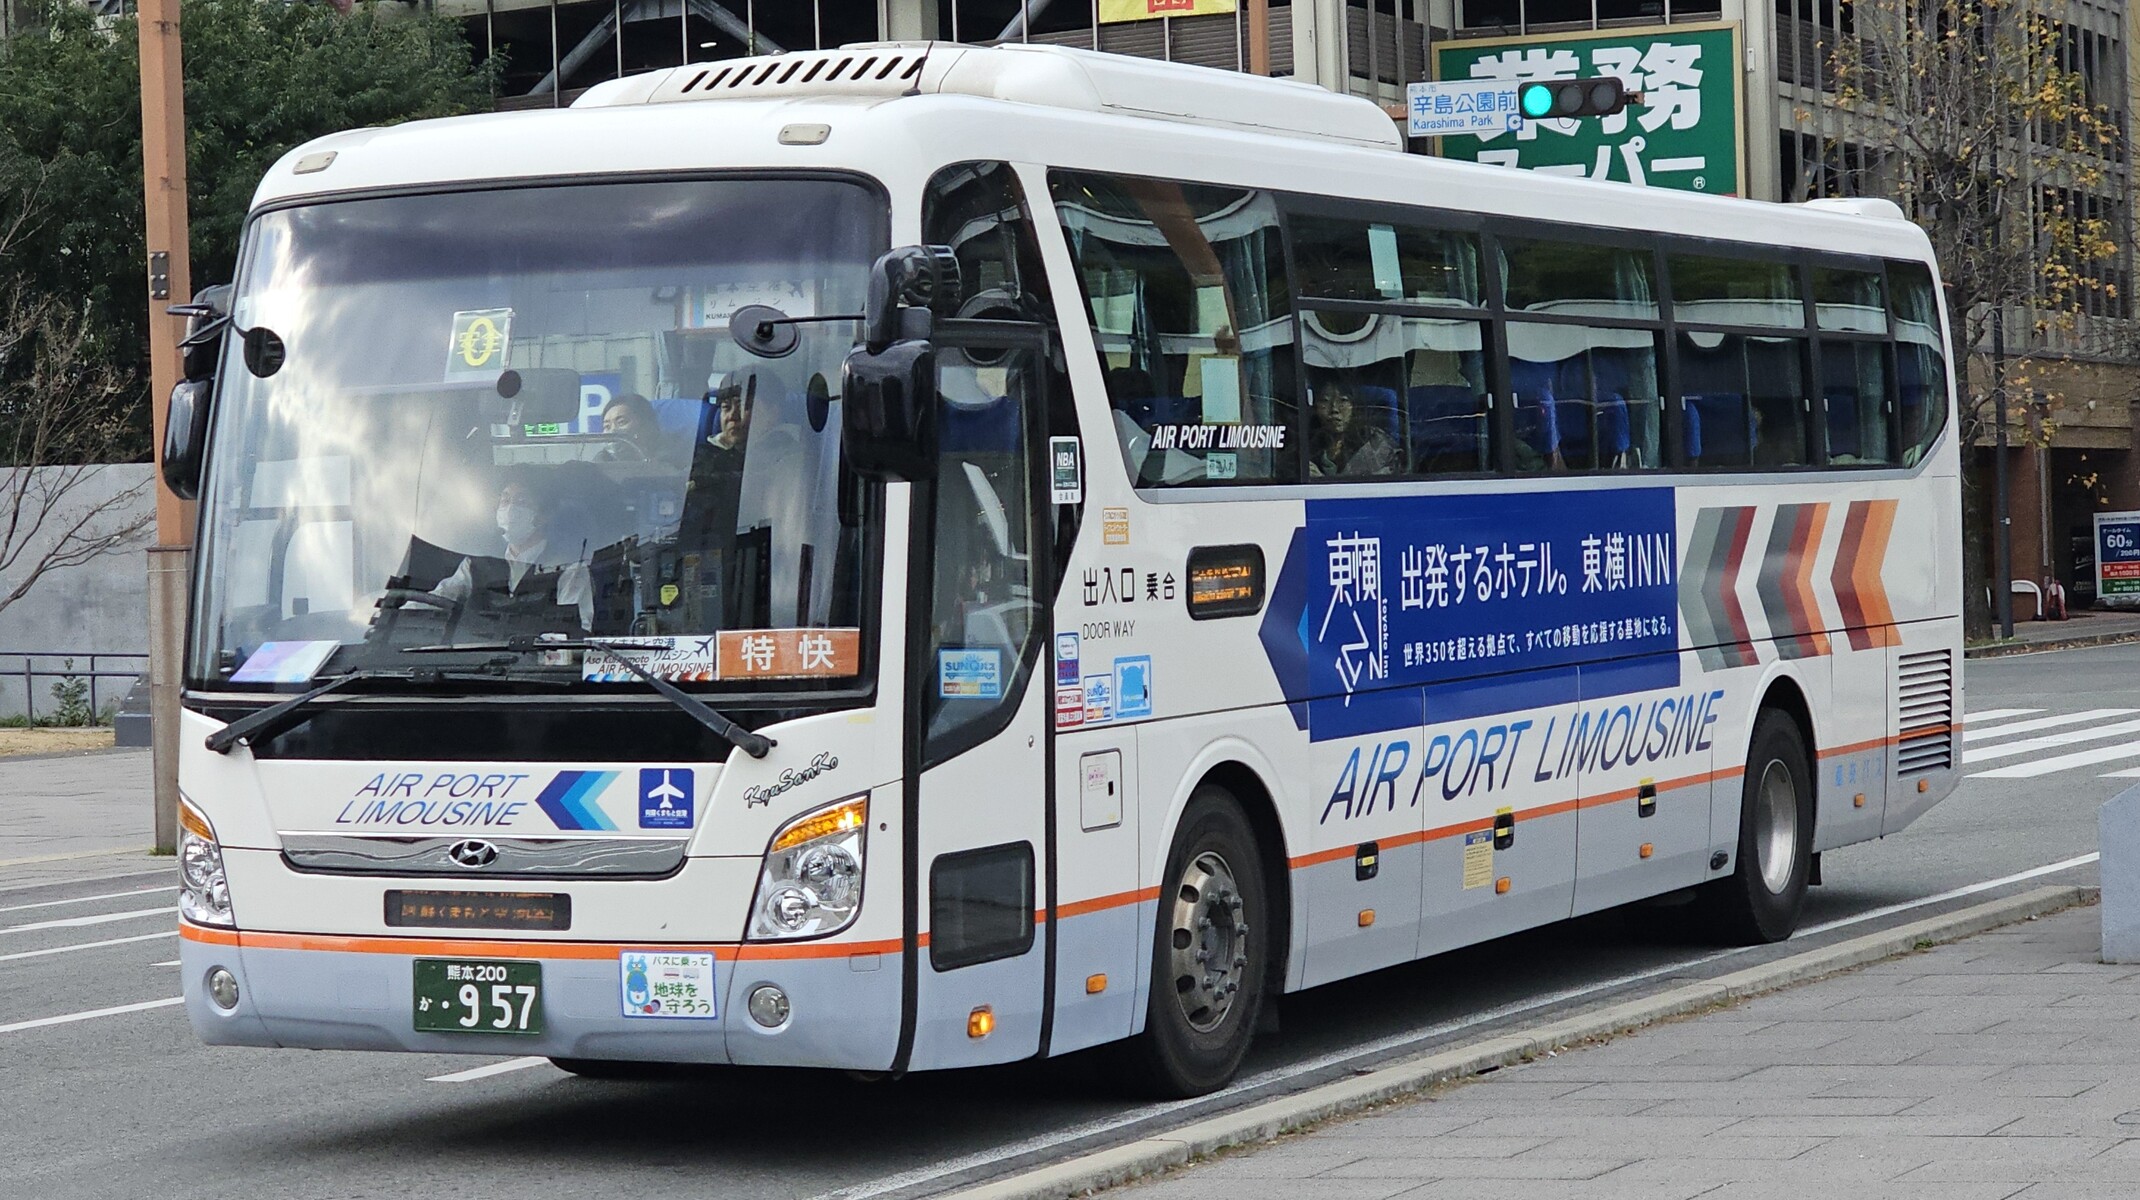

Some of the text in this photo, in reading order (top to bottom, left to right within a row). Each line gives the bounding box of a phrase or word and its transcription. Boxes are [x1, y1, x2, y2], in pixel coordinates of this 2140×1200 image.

[1414, 91, 1517, 116] 辛島公園前
[1413, 115, 1493, 130] Karashima Park
[1151, 425, 1286, 449] AIR PORT LIMOUSINE
[1056, 452, 1075, 467] NBA
[2107, 534, 2133, 548] 60分
[1401, 532, 1671, 612] 出発するホテル。 東横INN
[1083, 567, 1135, 606] 出入口
[1147, 571, 1176, 600] 乗合
[1083, 620, 1136, 640] DOOR WAY
[585, 655, 601, 664] Aso
[741, 634, 835, 671] 特快
[598, 662, 713, 674] AIR POT LIMOUSINE
[1321, 690, 1725, 825] AIR PORT LIMOUSINE
[354, 774, 530, 798] AIR PORT
[743, 752, 838, 807] KyuSanKo
[336, 801, 527, 826] LIMOUSINE
[653, 956, 708, 966] バスに乗って
[654, 983, 698, 998] 地球を
[665, 999, 711, 1014] 守ろう
